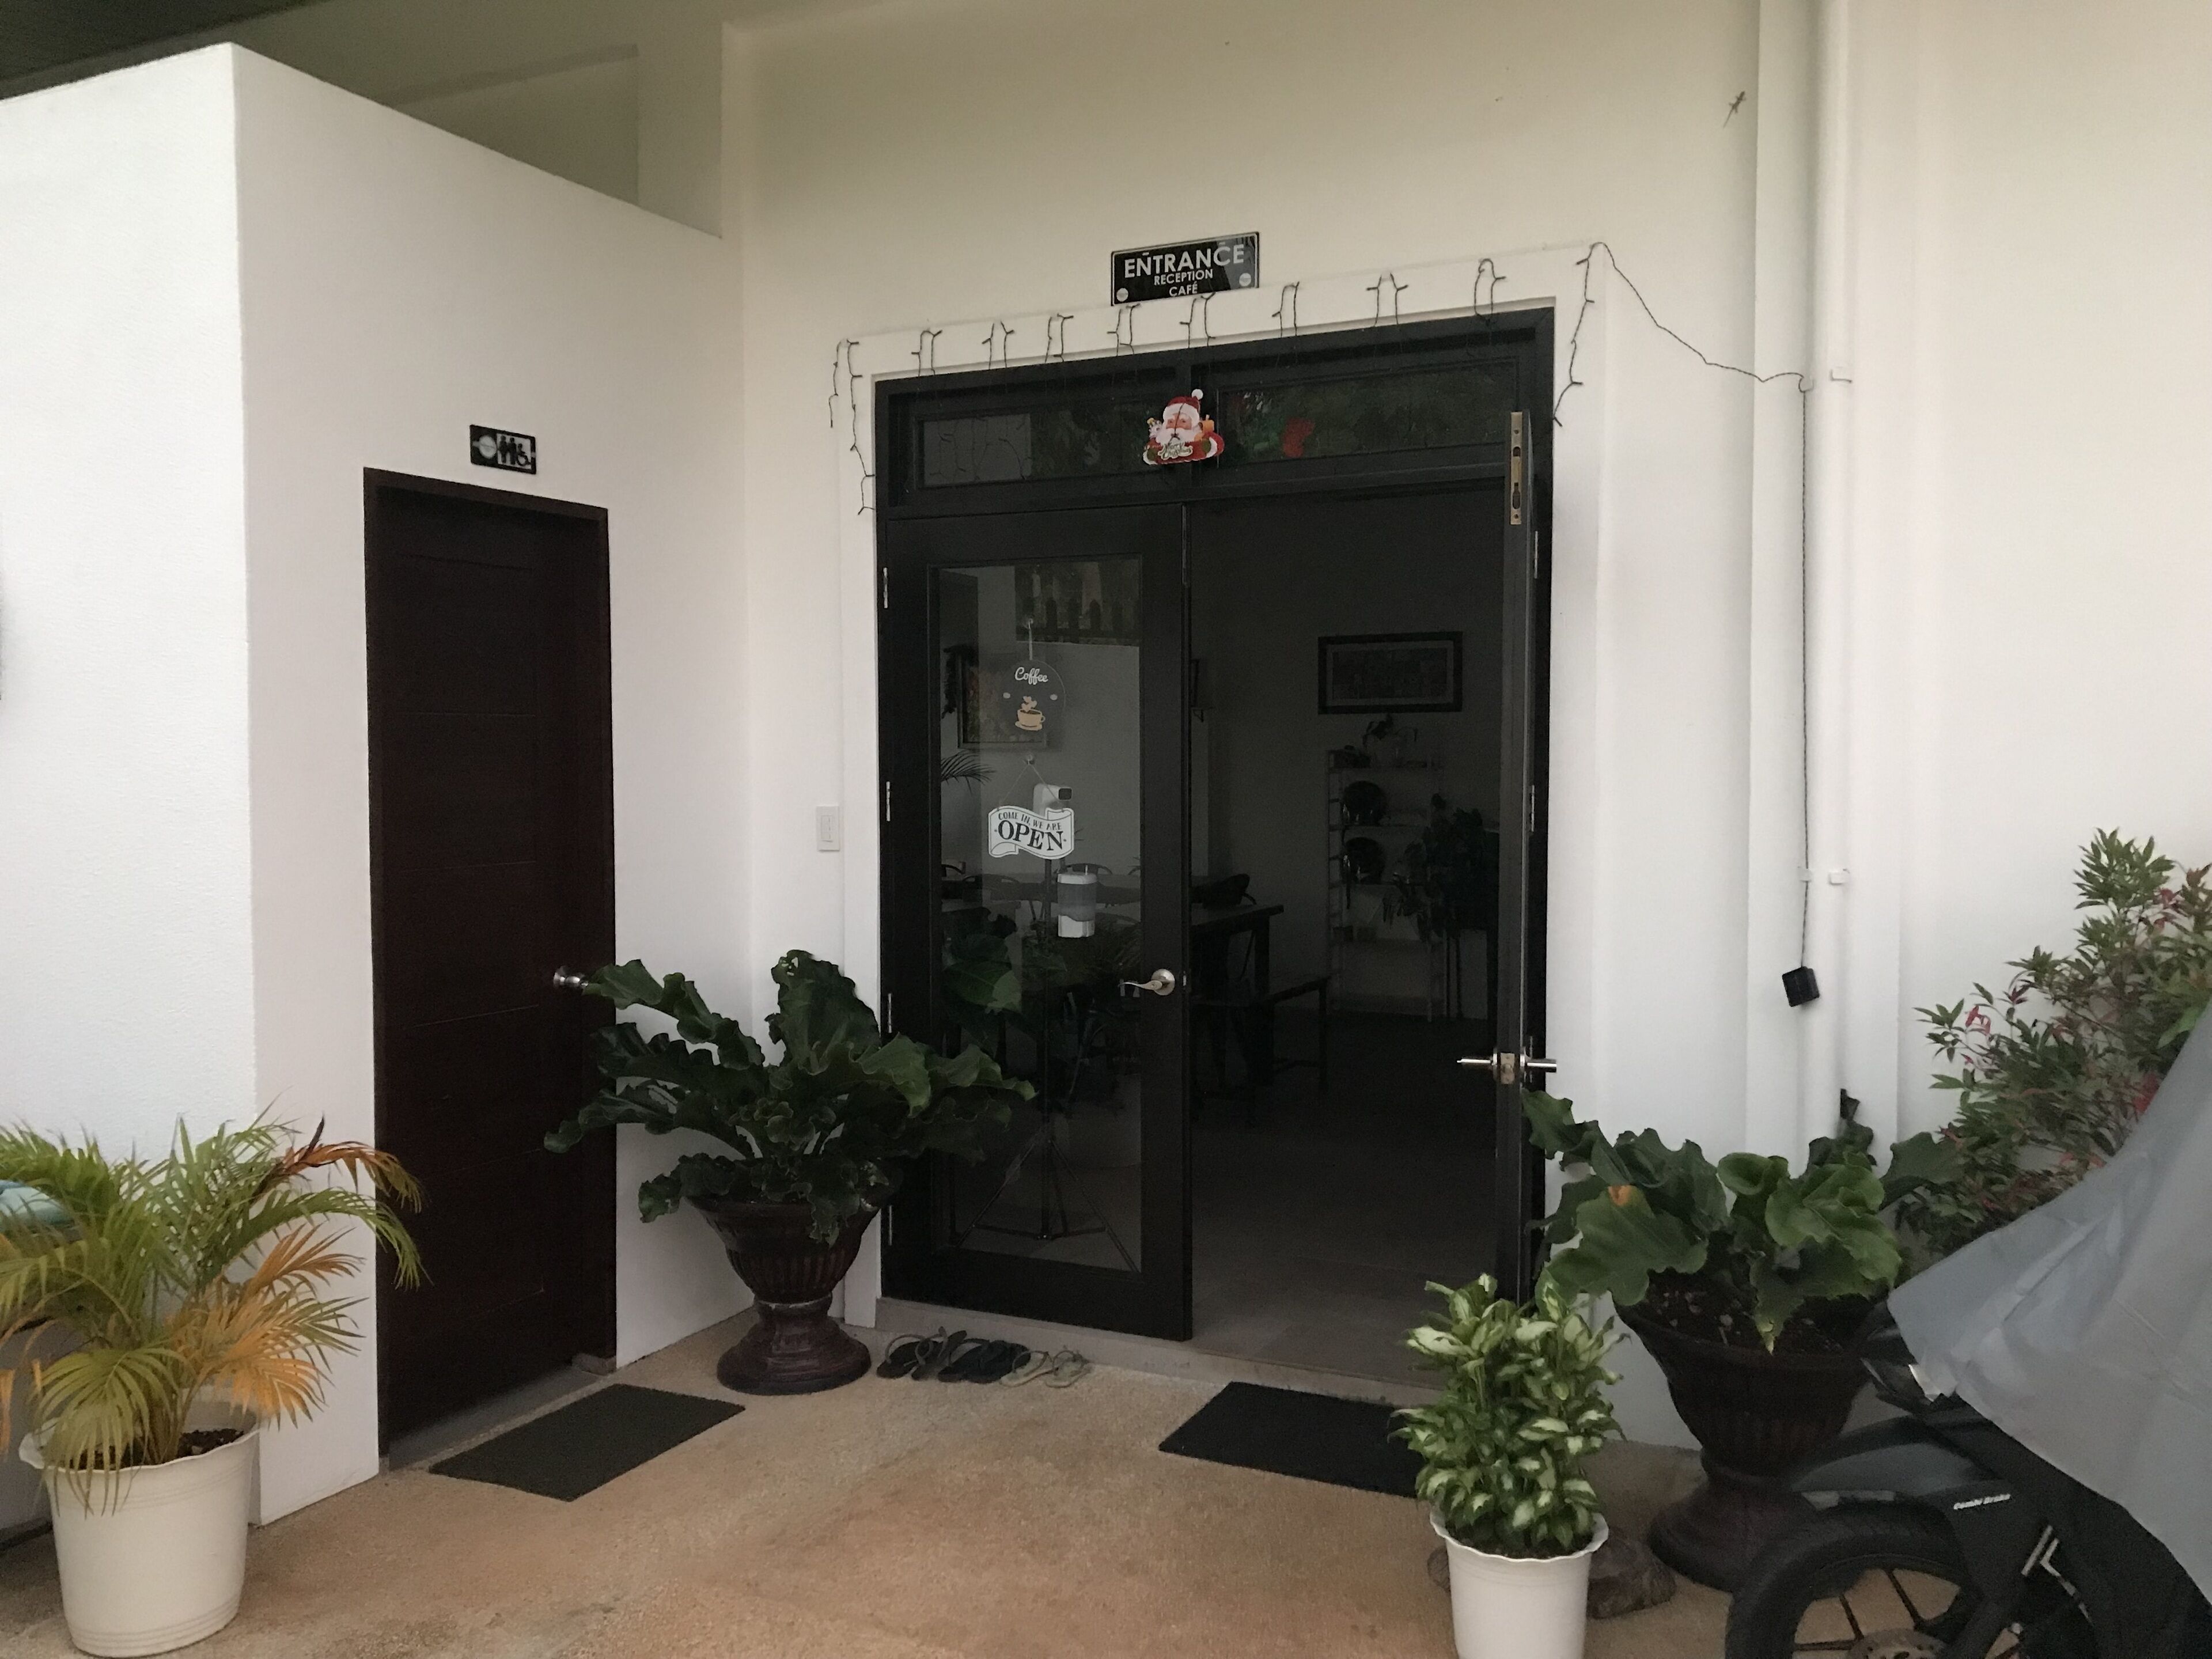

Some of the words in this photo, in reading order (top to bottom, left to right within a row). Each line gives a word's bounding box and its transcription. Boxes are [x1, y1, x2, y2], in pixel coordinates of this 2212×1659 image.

[1124, 244, 1244, 278] ENTRANCE
[1154, 268, 1213, 286] RECEPTION
[1169, 281, 1198, 297] CAFÉ
[1014, 666, 1048, 685] Coffee
[998, 812, 1018, 820] COME
[1033, 819, 1043, 828] WE
[1046, 822, 1061, 831] ARE
[998, 820, 1063, 851] OPEN
